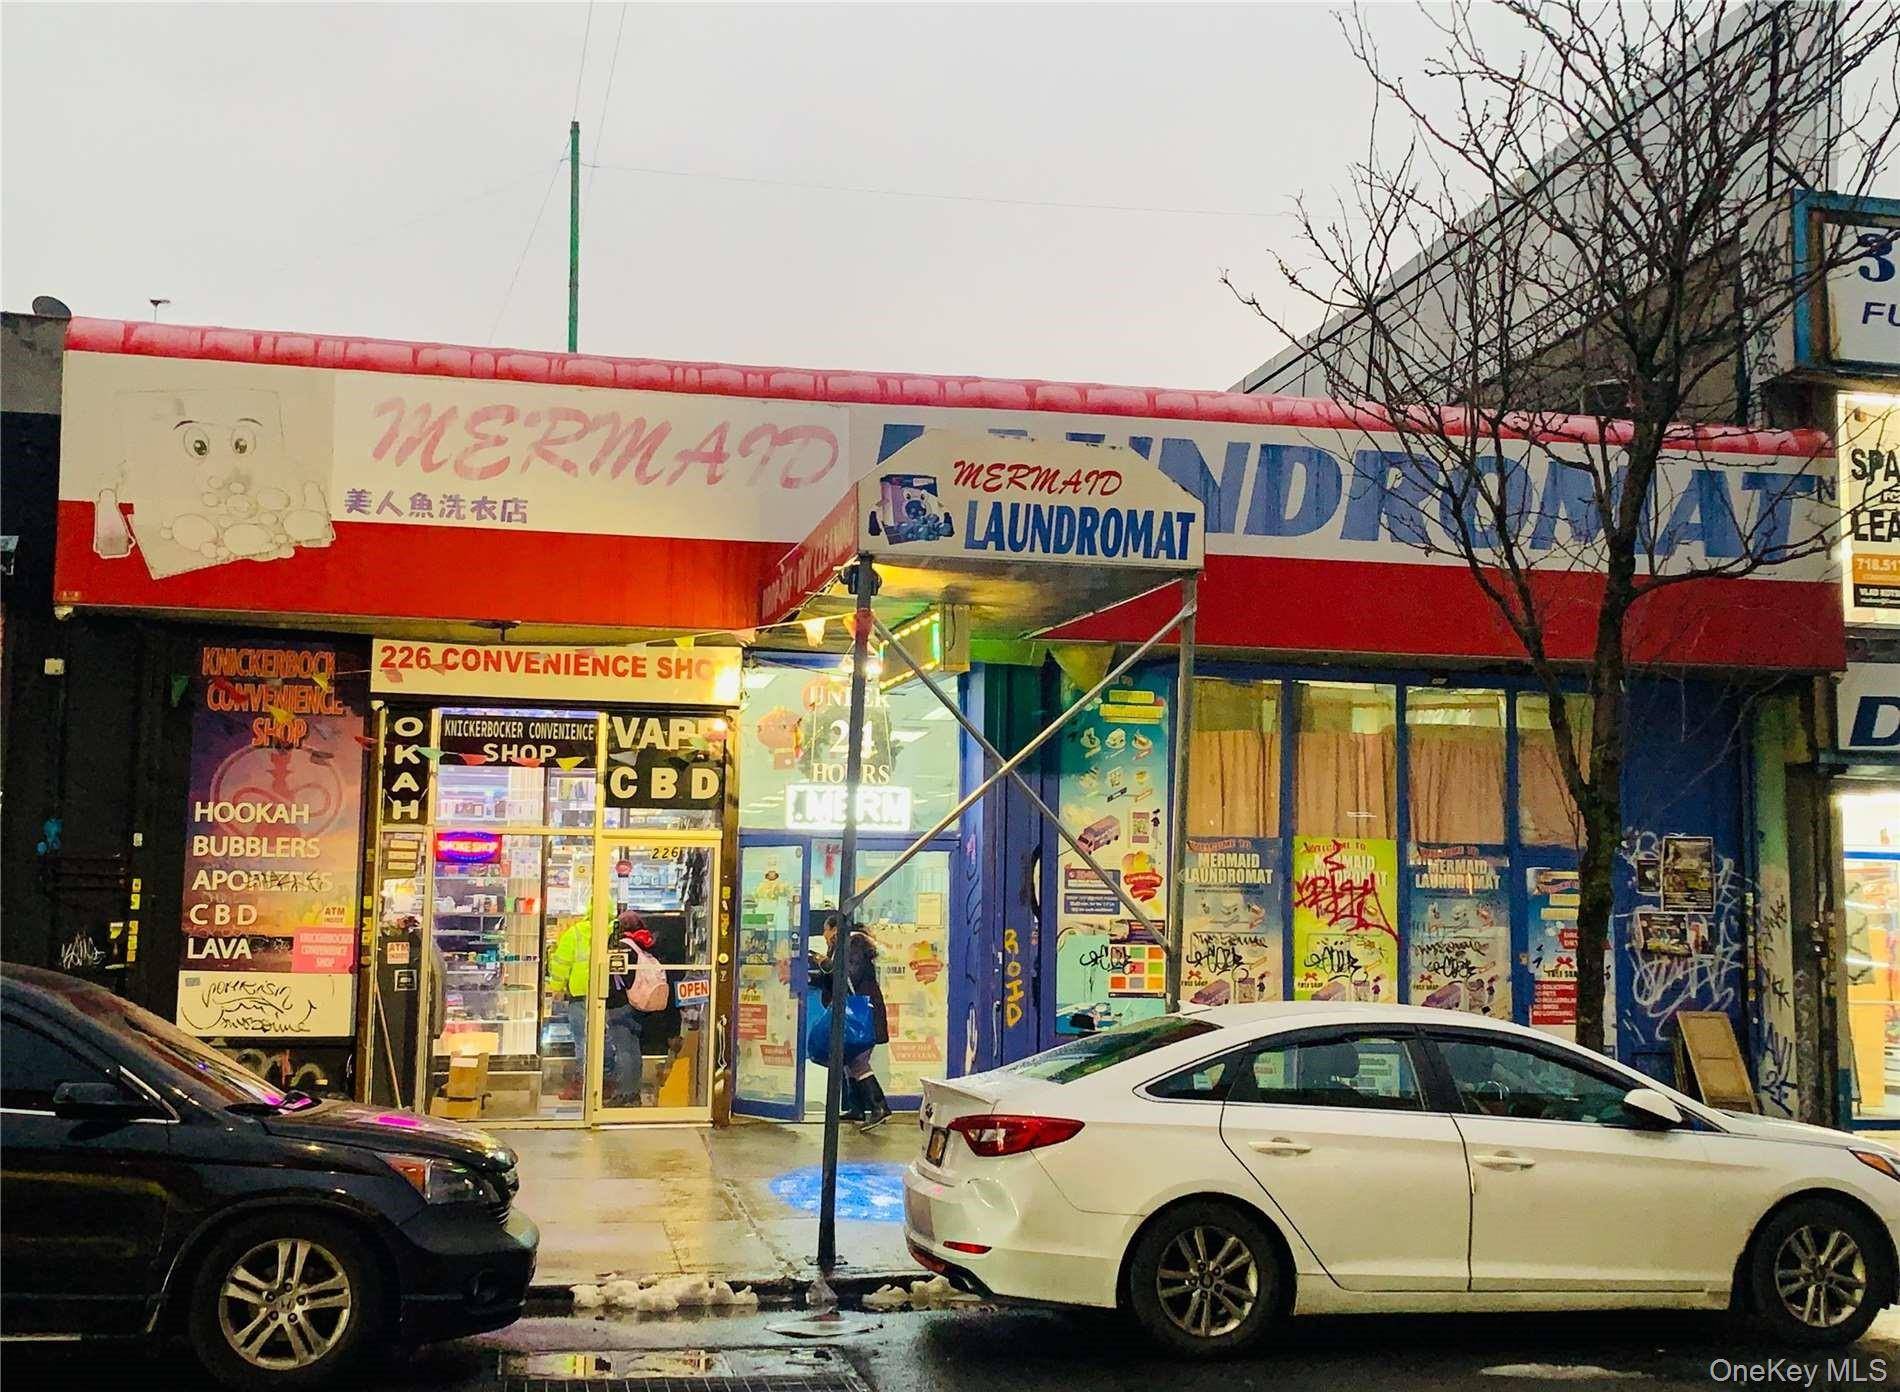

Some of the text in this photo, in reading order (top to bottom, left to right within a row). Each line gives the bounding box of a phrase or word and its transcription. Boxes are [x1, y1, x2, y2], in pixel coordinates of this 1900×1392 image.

[371, 396, 840, 489] MERMAID
[953, 460, 1124, 497] MERMAID
[877, 424, 1818, 563] NDROMAT
[344, 487, 529, 525] 美人魚洗衣店
[964, 499, 1196, 561] LAUNDROMAT
[380, 645, 720, 681] 226 CONVENIENCE SHO
[809, 687, 890, 707] UNER
[252, 716, 308, 747] SHOP
[444, 719, 595, 741] KNICKERBOCKER CONVENIENCE
[611, 716, 725, 751] VAP
[483, 743, 557, 763] SHOP
[812, 762, 891, 785] HORS
[194, 801, 311, 825] HOOKAH
[192, 835, 321, 858] BUBBLERS
[652, 847, 679, 860] 226
[1198, 852, 1260, 868] MERMAID
[1428, 859, 1488, 874] MERMAID
[1185, 867, 1274, 885] LAUNDROMAT
[324, 906, 345, 917] ATM
[187, 938, 252, 960] LAVA
[389, 942, 410, 951] ATM
[679, 981, 709, 998] OPEN
